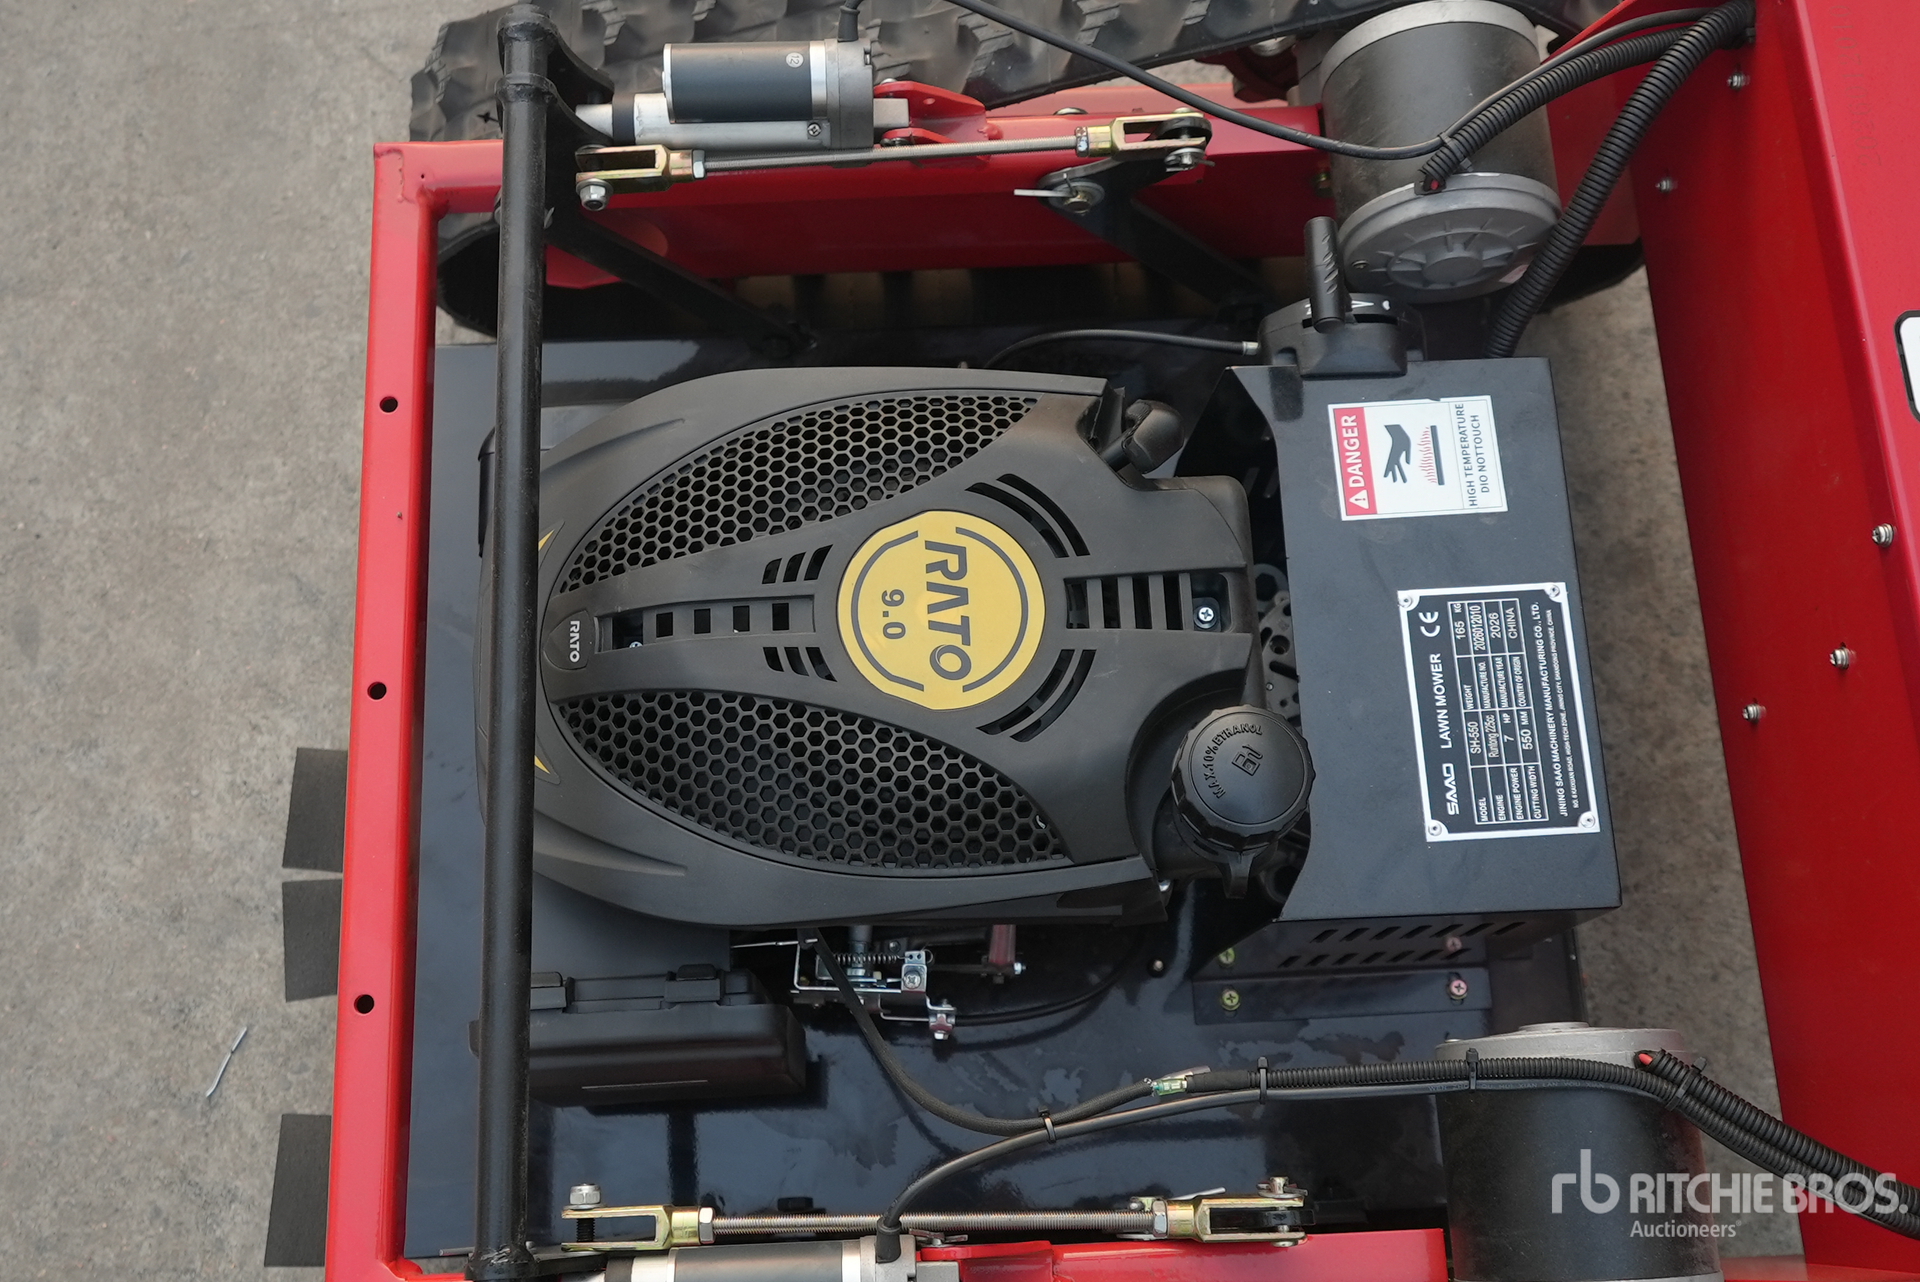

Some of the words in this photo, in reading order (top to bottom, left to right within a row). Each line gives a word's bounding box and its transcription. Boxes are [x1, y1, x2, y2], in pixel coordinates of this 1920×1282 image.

[789, 55, 800, 65] 12
[1341, 415, 1365, 487] DANGER
[1455, 403, 1473, 477] TEMPERATURE
[1470, 415, 1487, 471] NOTTOUCH
[1467, 481, 1478, 506] HIGH
[1479, 476, 1490, 493] DIO
[880, 588, 907, 640] 9.0
[924, 539, 973, 681] RATO
[1454, 603, 1462, 612] KG
[1531, 602, 1540, 619] LTD.
[1419, 612, 1440, 637] CE
[1455, 621, 1466, 639] 165
[1470, 606, 1485, 650] 2026012010
[1489, 613, 1501, 638] 2026
[1506, 608, 1518, 639] CHINA
[1534, 621, 1542, 638] CO.,
[567, 619, 582, 663] RATO
[1547, 626, 1557, 652] PROVINCE,
[1495, 657, 1504, 670] YEAR
[1513, 656, 1522, 674] ORIGIN
[1535, 639, 1553, 710] MANUFACTURING
[1552, 653, 1561, 680] SHANDONG
[1430, 653, 1447, 706] MOWER
[1479, 672, 1491, 708] MANUFACTURE
[1498, 671, 1509, 707] MANUFACTURE
[1464, 685, 1474, 709] WEIGHT
[1516, 683, 1526, 706] COUNTRY
[1557, 694, 1566, 710] JINING
[1436, 709, 1452, 748] LAWN
[1485, 715, 1496, 732] 225cc
[1503, 713, 1511, 723] HP
[1520, 712, 1529, 724] MM
[1468, 722, 1481, 754] SH-550
[1521, 729, 1533, 749] 550
[1546, 712, 1560, 761] MACHINERY
[1553, 763, 1564, 786] SAAO
[1566, 755, 1574, 771] ROAD,
[1442, 763, 1459, 815] SAAO
[1510, 768, 1520, 793] POWER
[1528, 766, 1537, 788] WIDTH
[1479, 797, 1488, 821] MODEL
[1496, 795, 1506, 820] ENGINE
[1514, 794, 1524, 819] ENGINE
[1531, 789, 1542, 818] CUTTING
[1556, 788, 1568, 816] JINING
